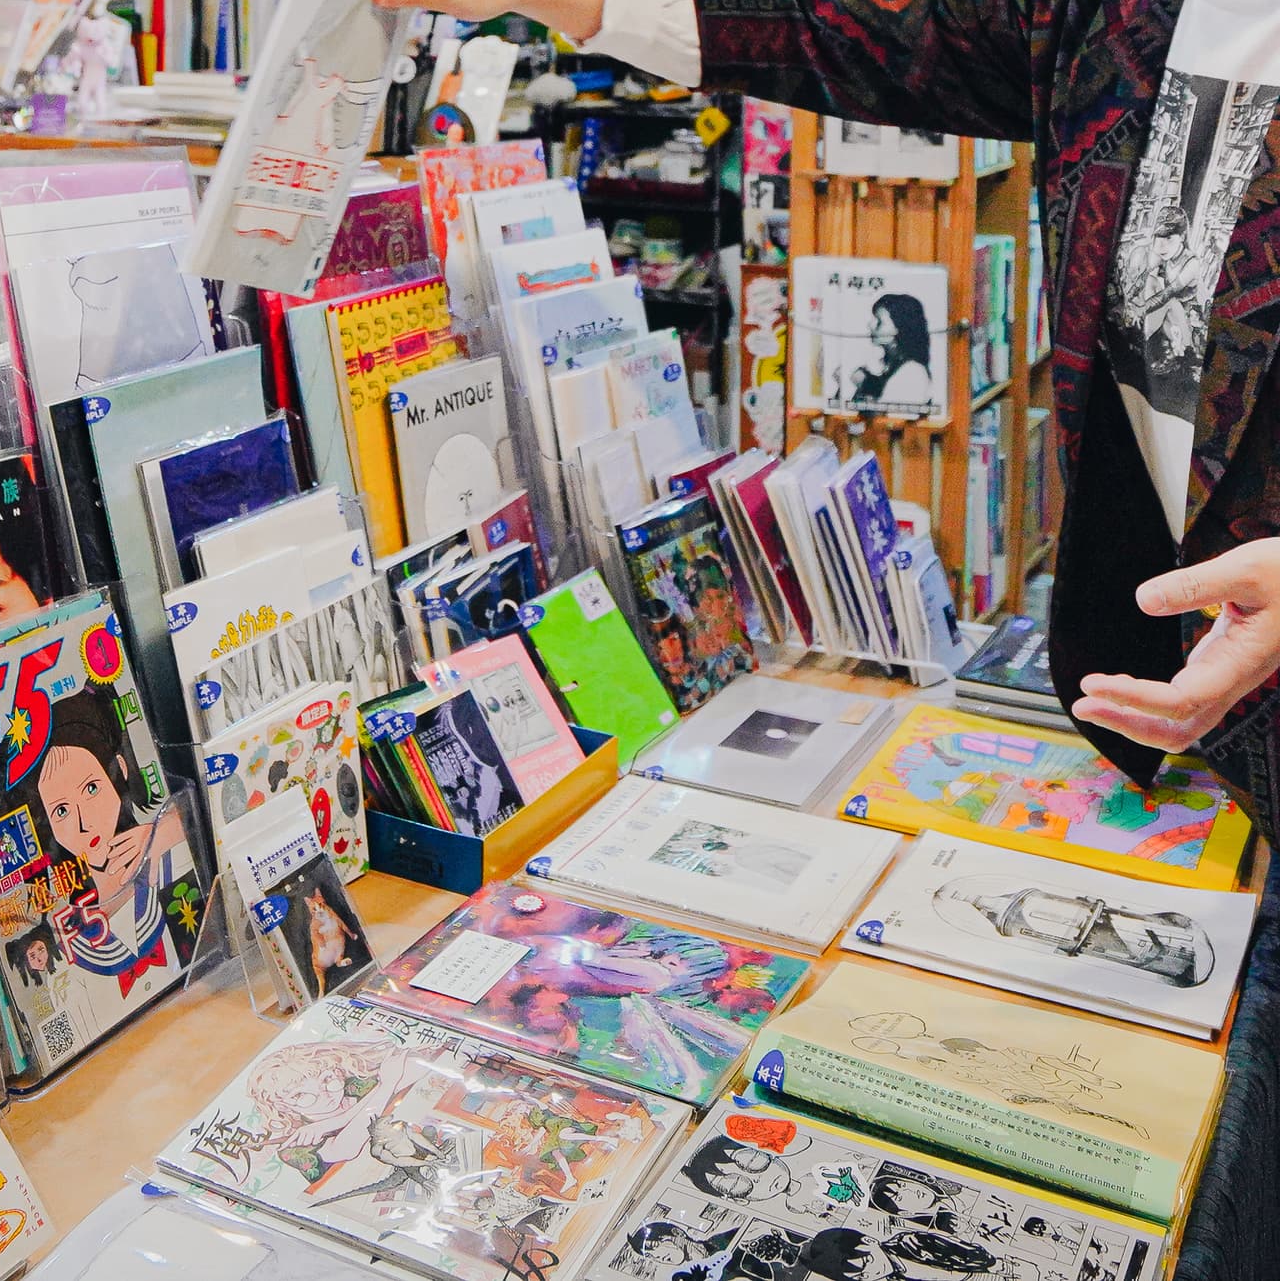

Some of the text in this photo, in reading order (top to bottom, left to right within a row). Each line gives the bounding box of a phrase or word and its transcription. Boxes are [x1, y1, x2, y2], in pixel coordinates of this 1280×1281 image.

[406, 380, 494, 429] Mr. ANTIQUE
[995, 1143, 1018, 1157] from
[1020, 1151, 1056, 1169] Bremen
[1057, 1164, 1127, 1194] Entertainment
